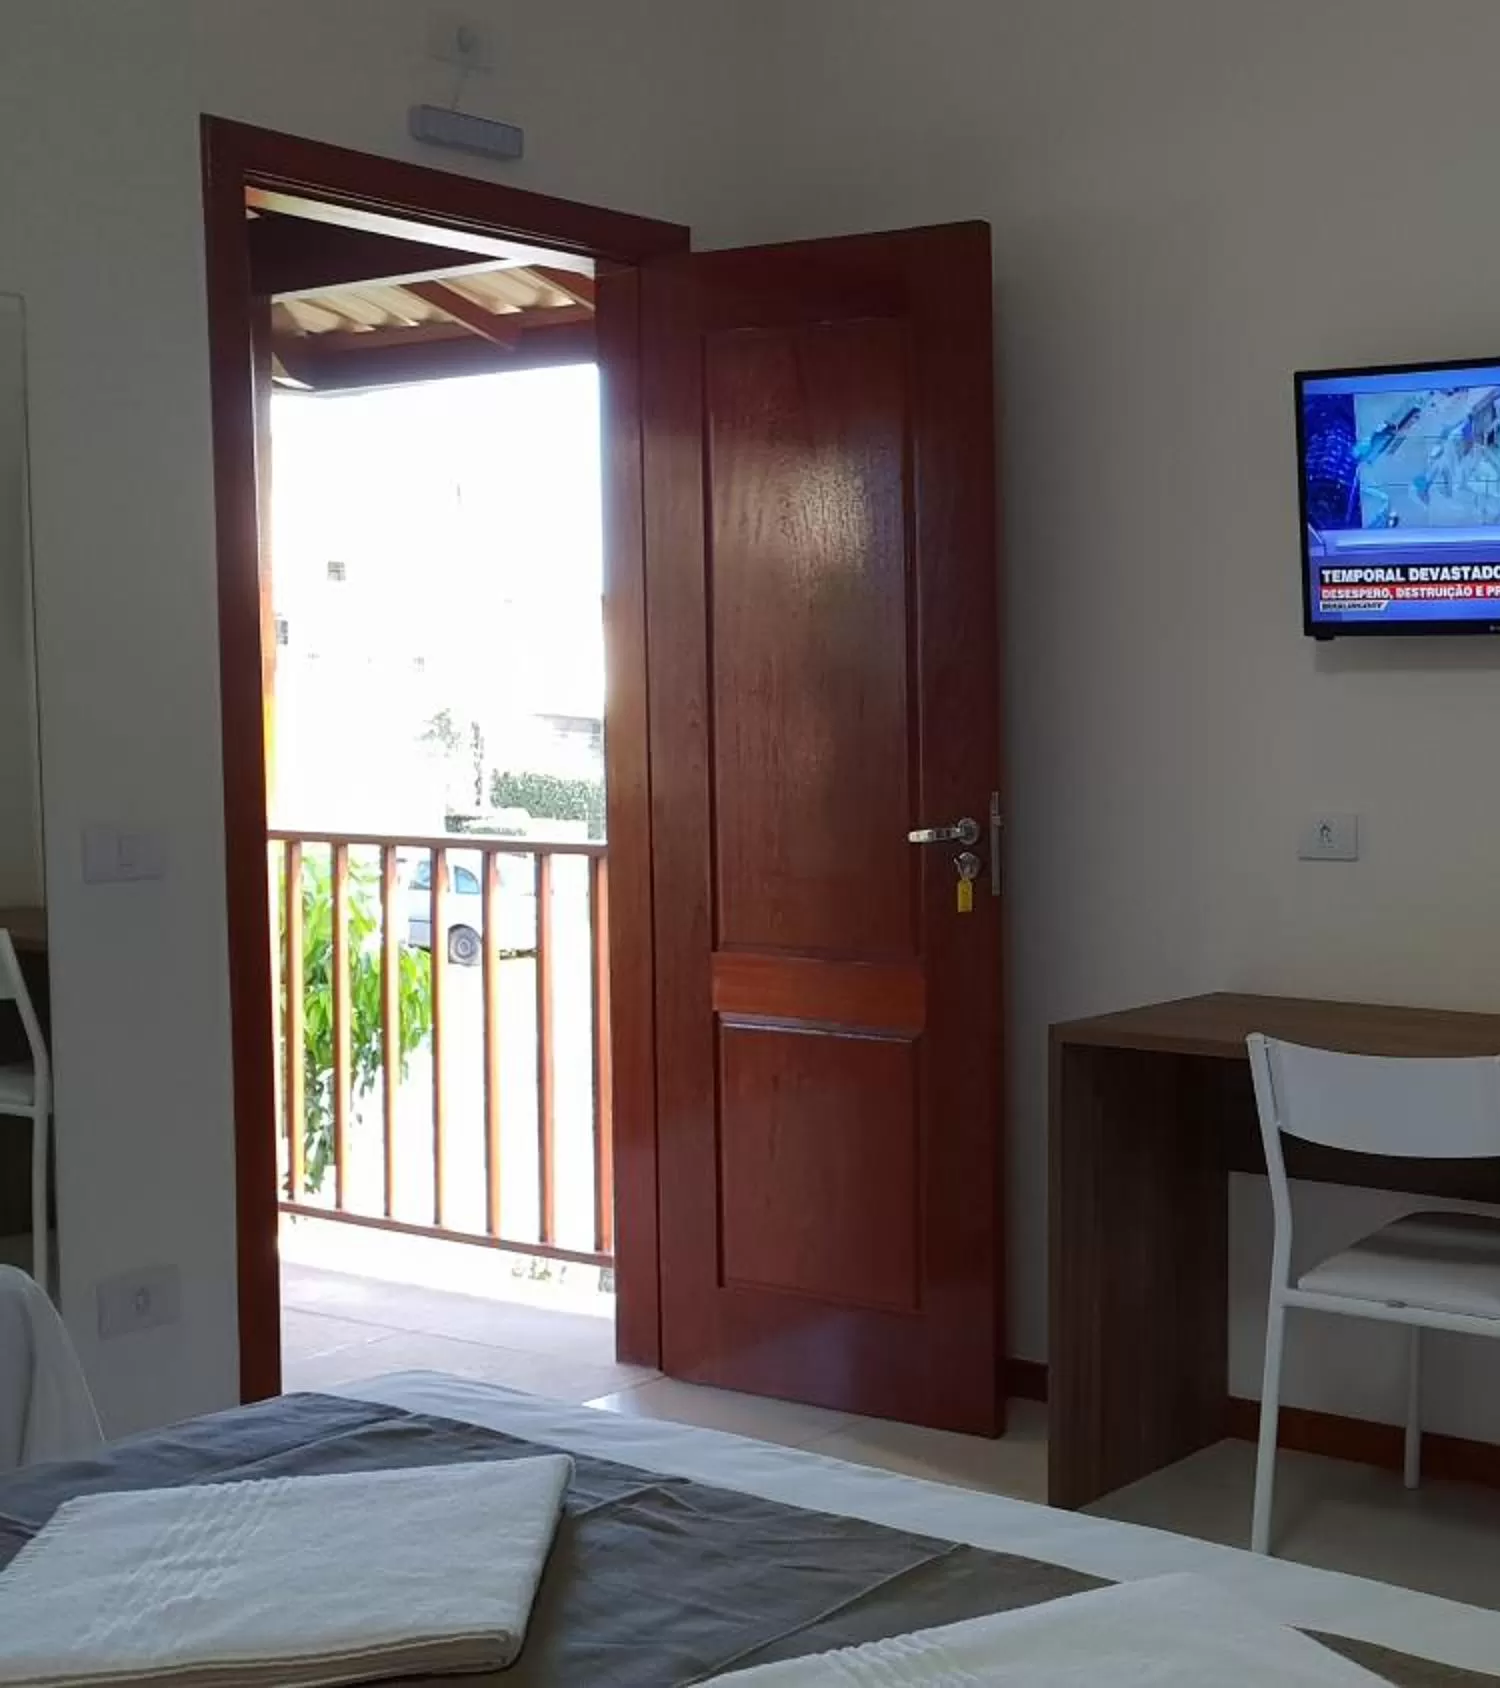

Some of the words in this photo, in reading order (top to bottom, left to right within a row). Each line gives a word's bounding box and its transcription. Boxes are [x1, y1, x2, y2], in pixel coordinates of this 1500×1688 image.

[1321, 569, 1406, 583] TEMPORAL
[1395, 583, 1473, 600] DESTRUIÇÃO
[1475, 585, 1485, 597] E
